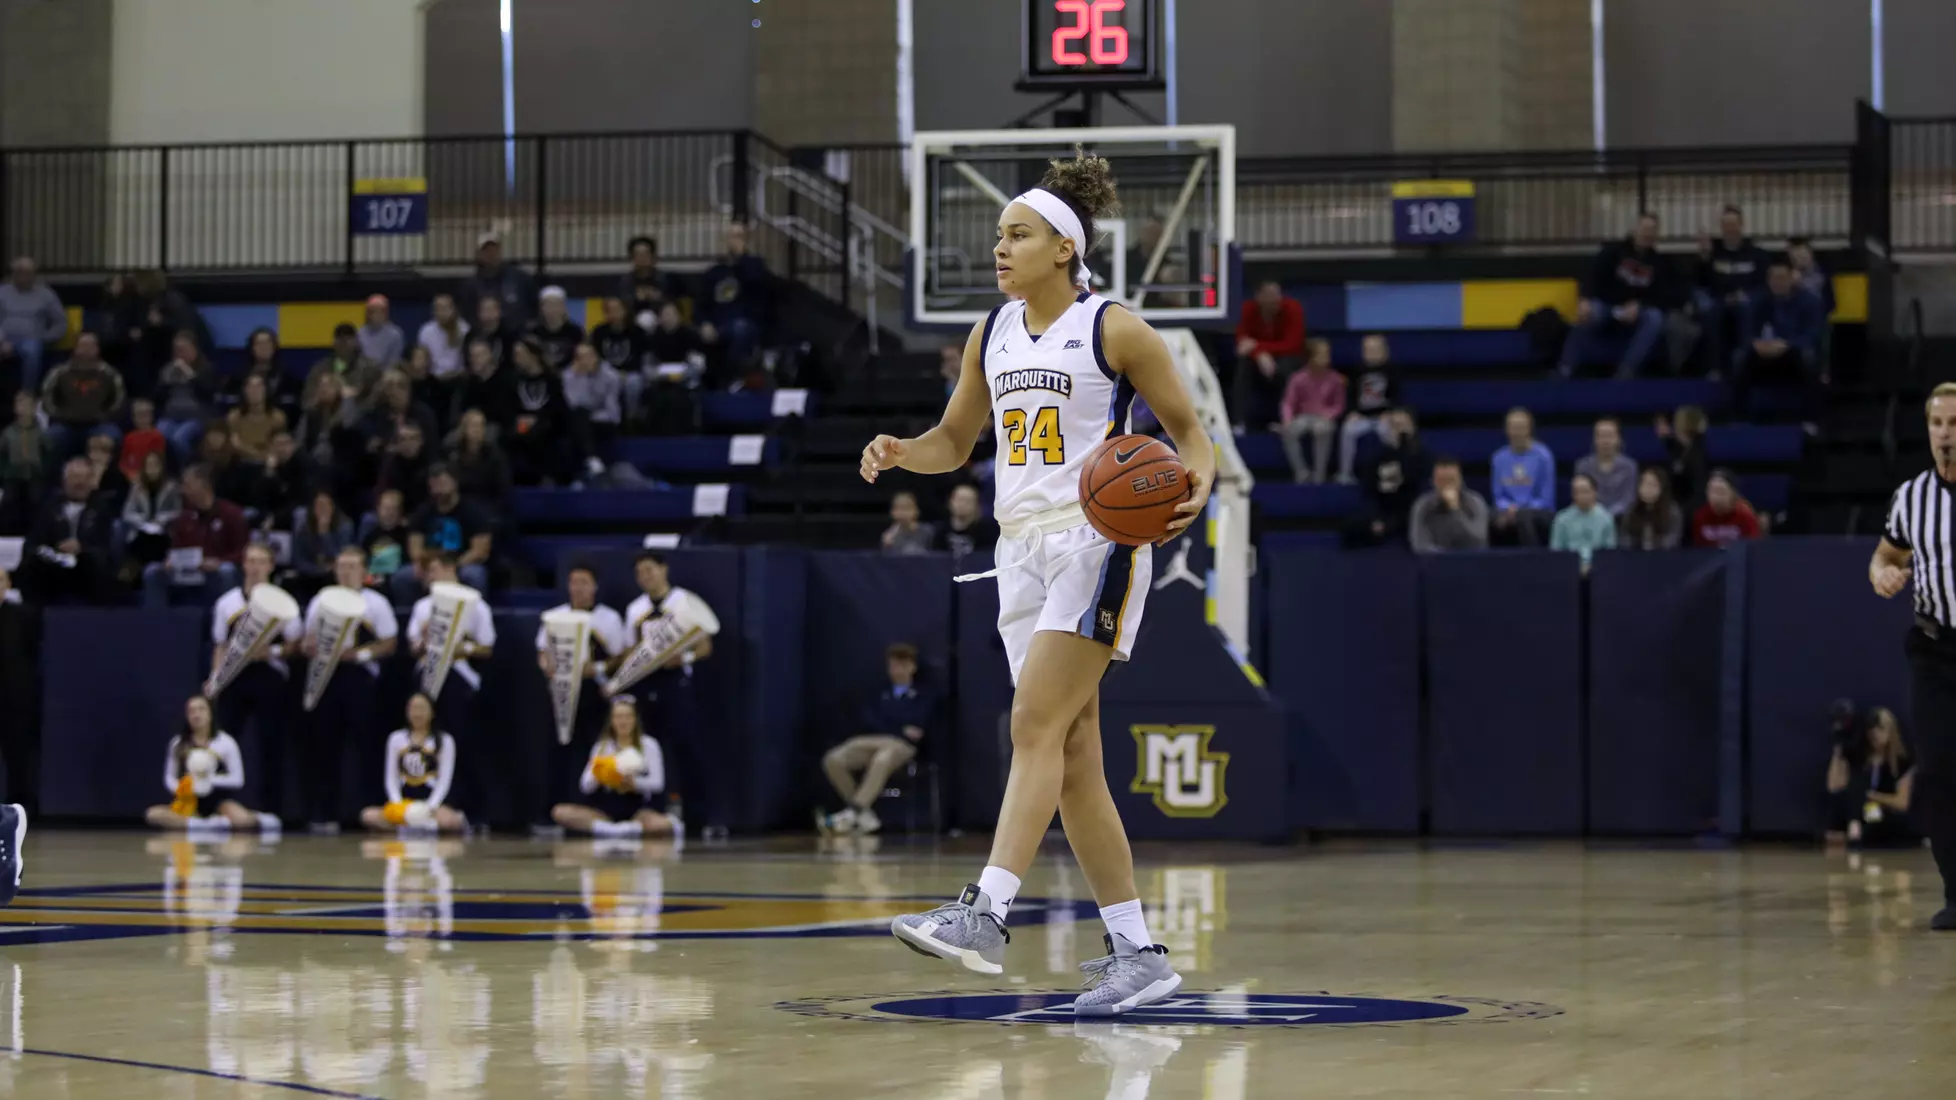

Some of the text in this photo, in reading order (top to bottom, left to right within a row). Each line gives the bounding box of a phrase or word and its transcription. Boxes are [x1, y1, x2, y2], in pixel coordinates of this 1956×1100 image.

[1052, 0, 1128, 65] 26
[368, 199, 413, 229] 107
[1407, 202, 1461, 234] 108
[995, 368, 1072, 400] MARQUETTE
[1002, 406, 1065, 466] 24
[1132, 469, 1179, 493] ELITE
[1100, 609, 1115, 632] MU
[1136, 727, 1222, 812] MU
